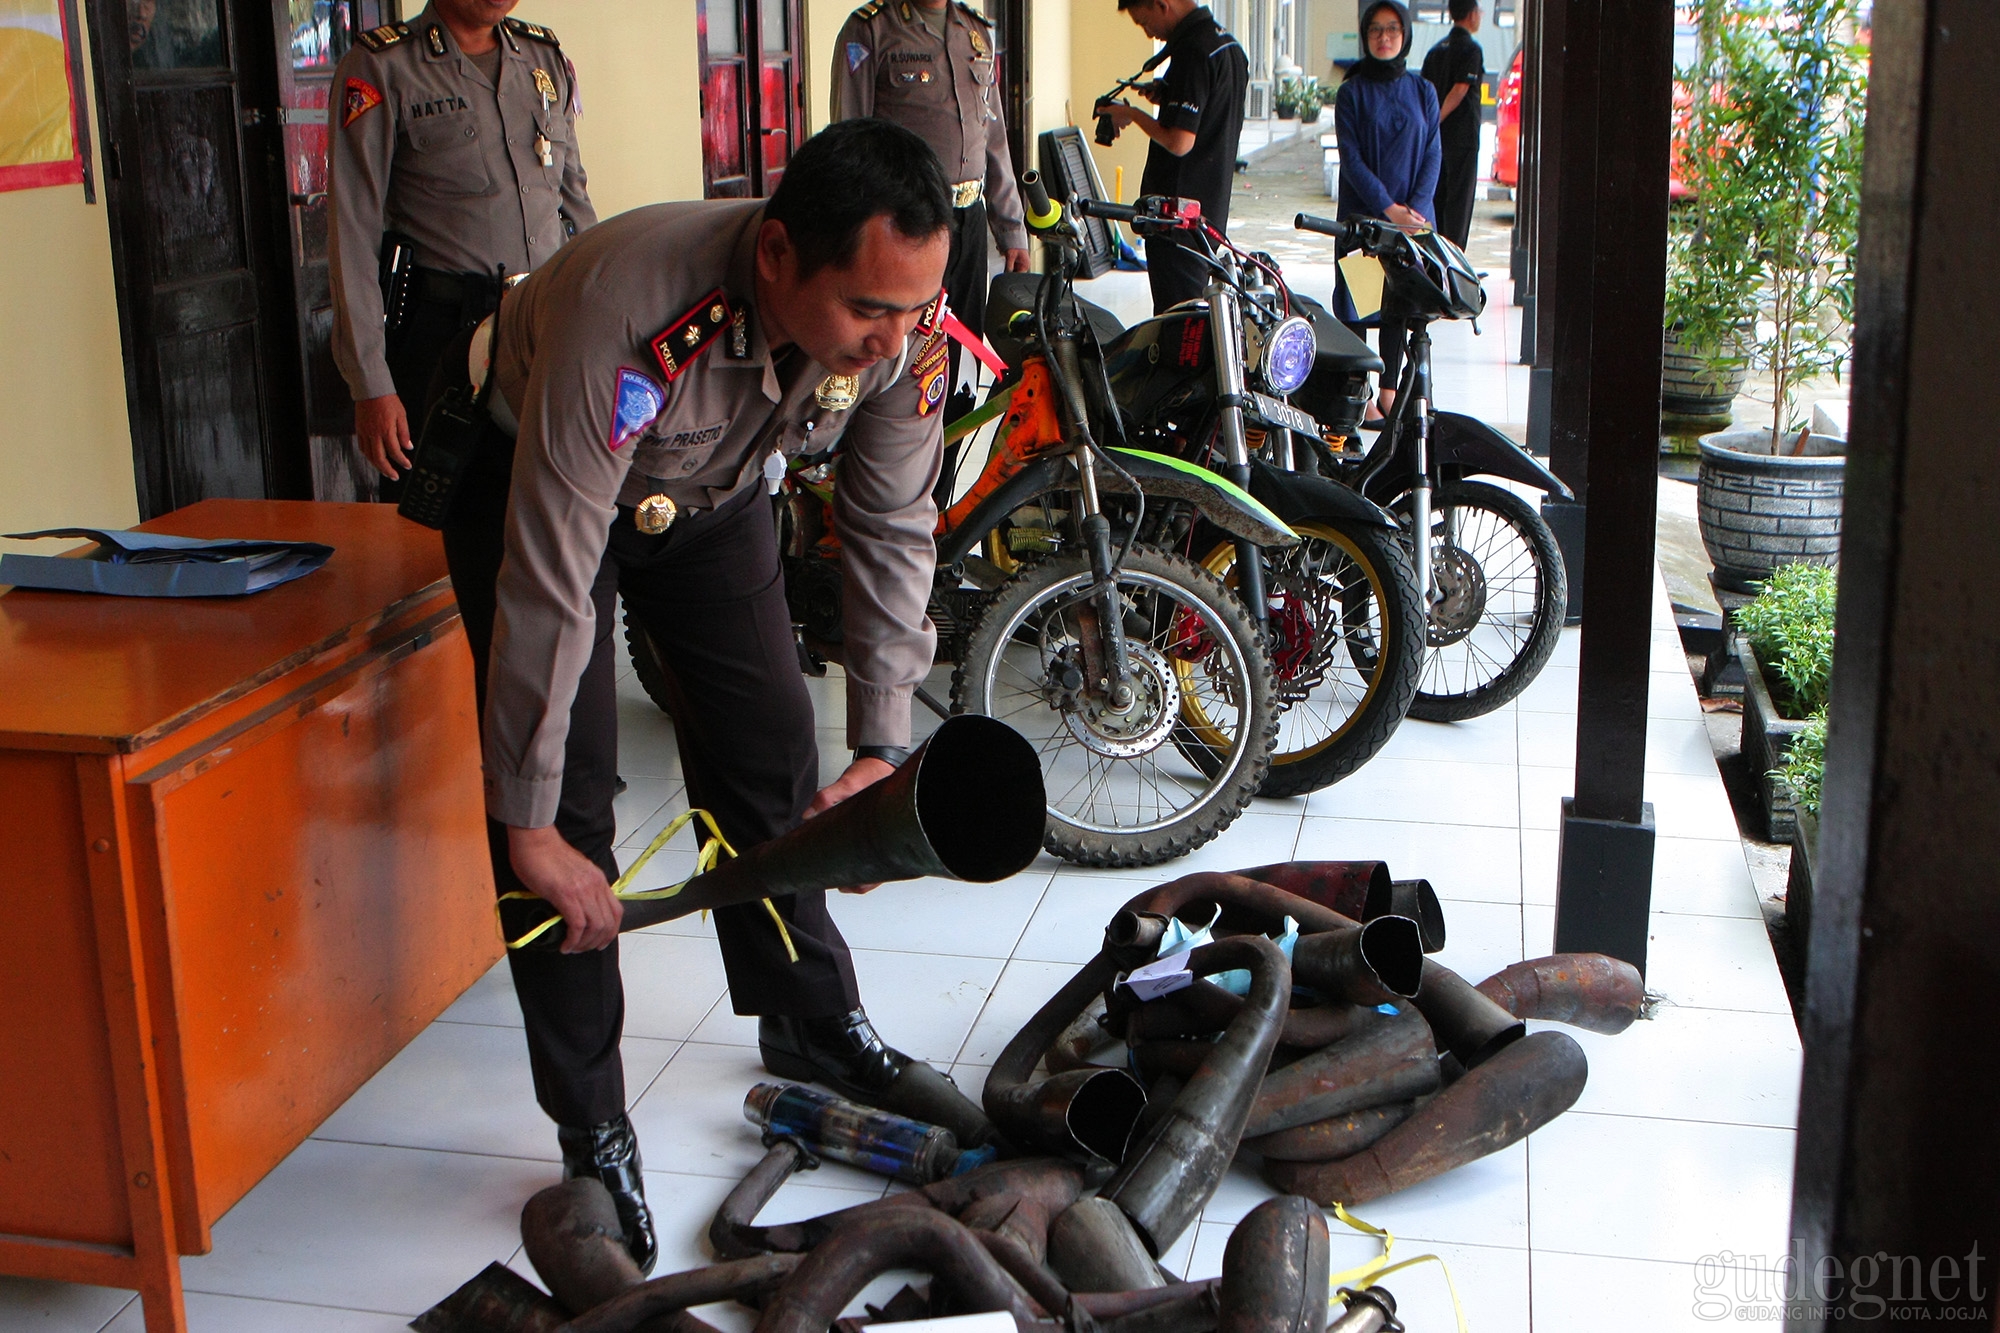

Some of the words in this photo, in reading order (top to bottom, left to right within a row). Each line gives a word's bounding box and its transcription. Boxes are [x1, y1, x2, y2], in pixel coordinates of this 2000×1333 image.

[411, 97, 468, 119] HATTA
[659, 341, 678, 374] POLISI
[1256, 396, 1268, 416] H
[1273, 402, 1304, 431] 3078
